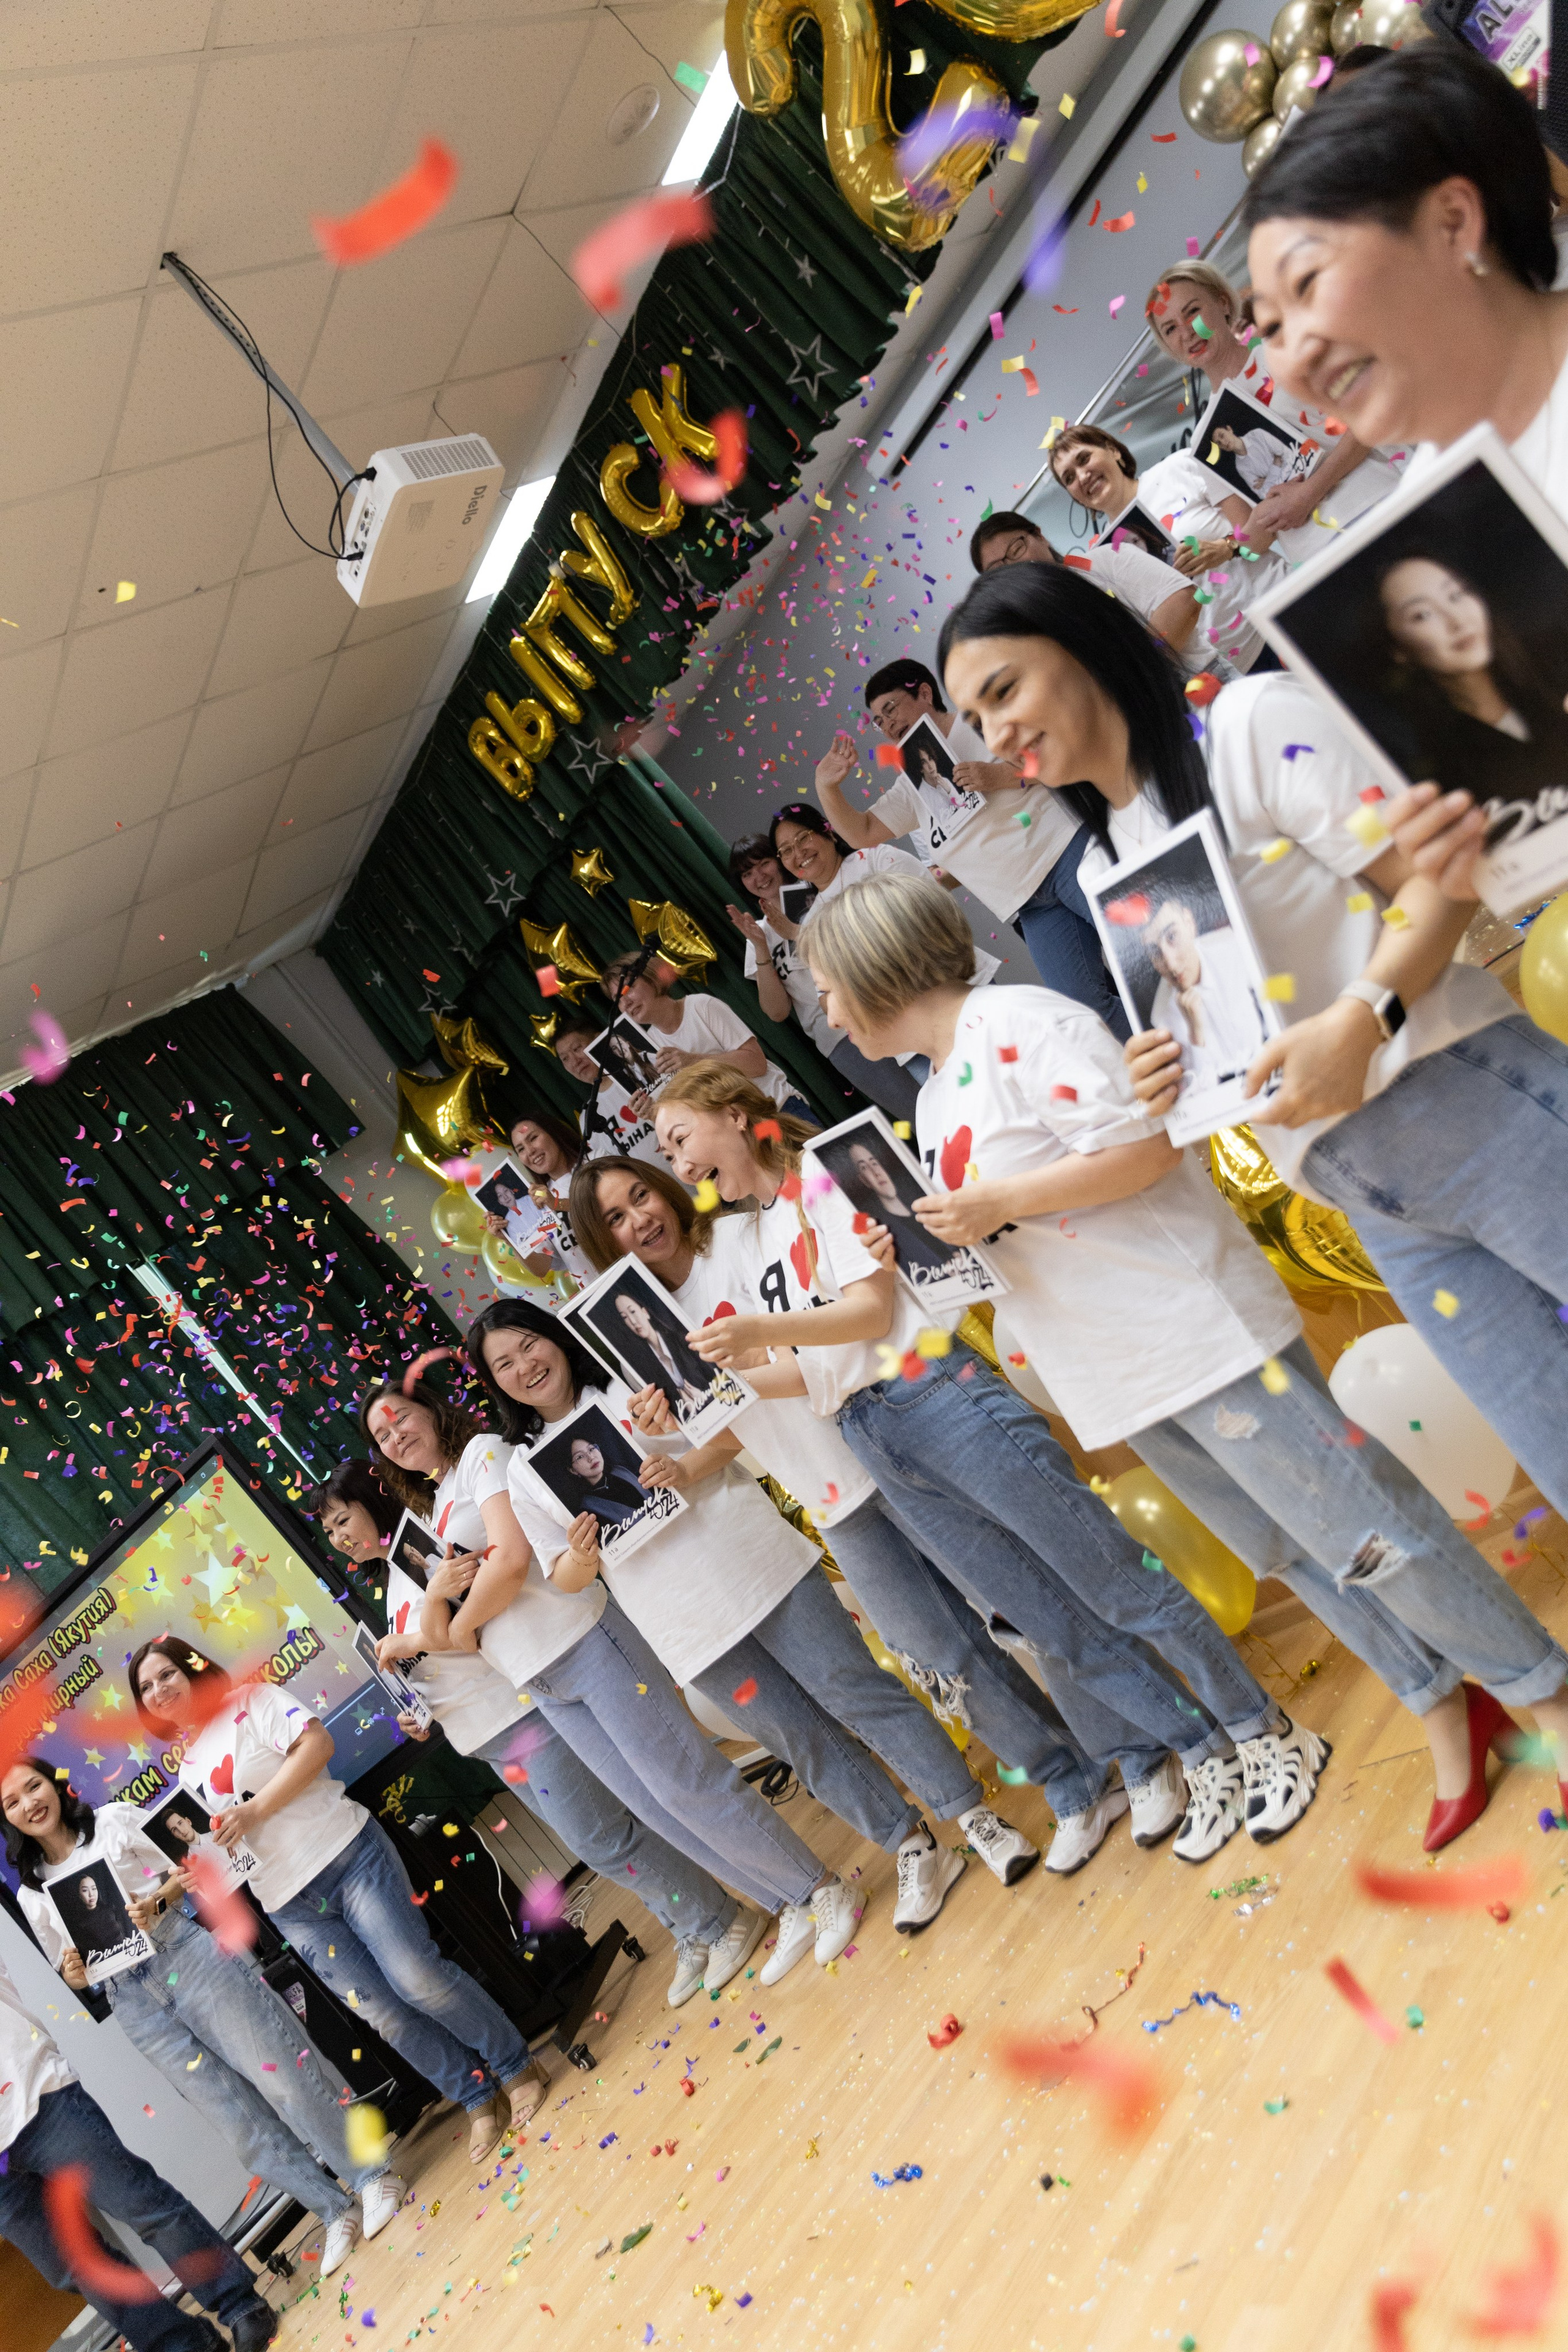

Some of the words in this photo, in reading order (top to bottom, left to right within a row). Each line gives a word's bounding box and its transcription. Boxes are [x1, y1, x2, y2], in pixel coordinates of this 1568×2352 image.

[462, 484, 488, 526] Diello
[469, 363, 723, 802] ВЫПУСК
[760, 1259, 791, 1313] Я
[649, 1491, 680, 1520] 2024
[13, 1650, 57, 1690] Саха
[48, 1587, 116, 1658] (Якутия)
[232, 1852, 256, 1872] 2024
